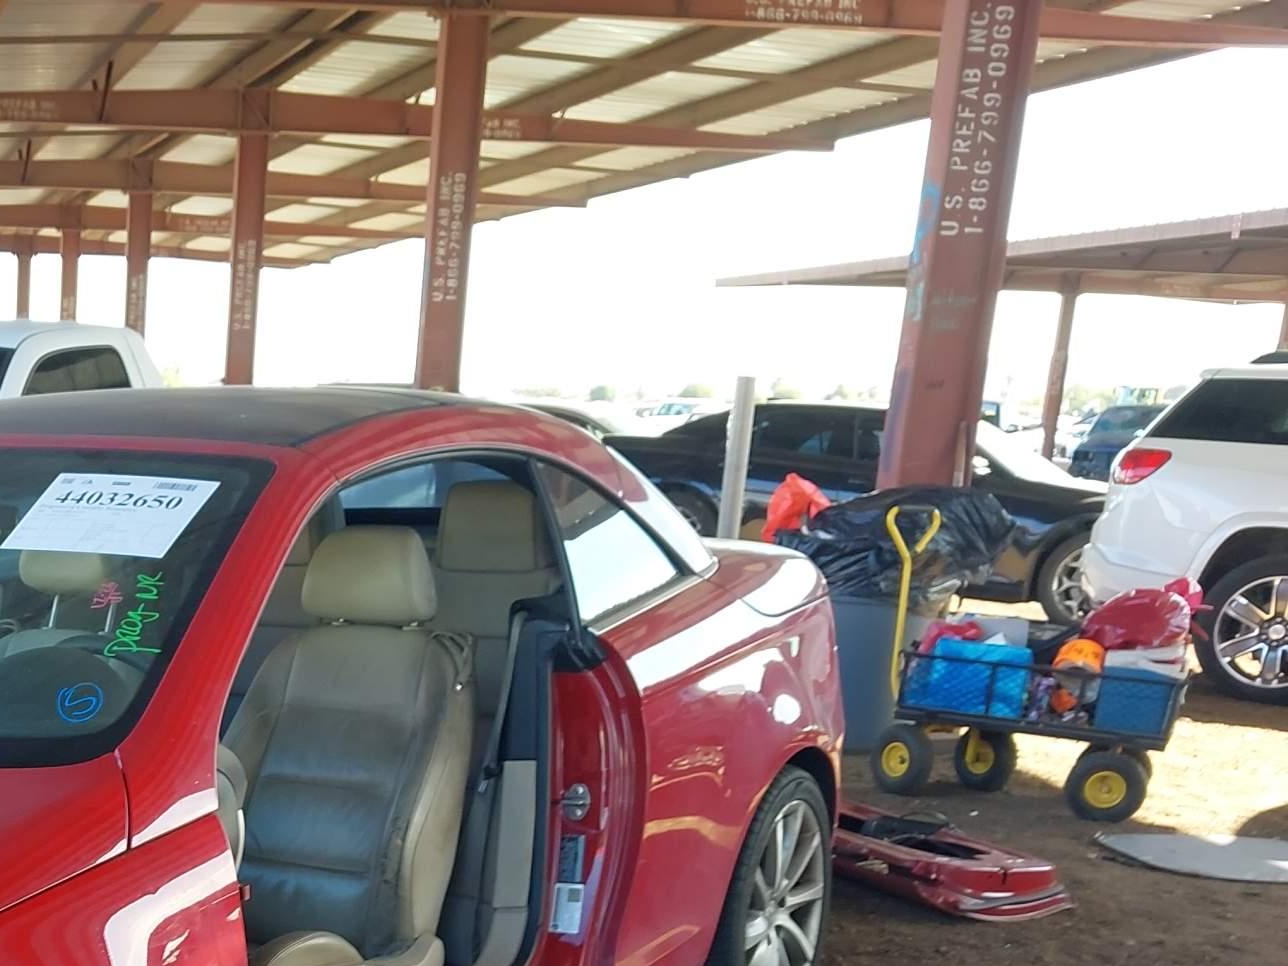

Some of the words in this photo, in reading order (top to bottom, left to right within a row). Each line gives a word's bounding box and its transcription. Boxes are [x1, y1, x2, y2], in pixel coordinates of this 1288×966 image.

[951, 67, 982, 171] PREFAB
[968, 3, 993, 53] INC.
[964, 5, 1015, 235] 1-866-799-0969
[55, 490, 184, 510] 44032650
